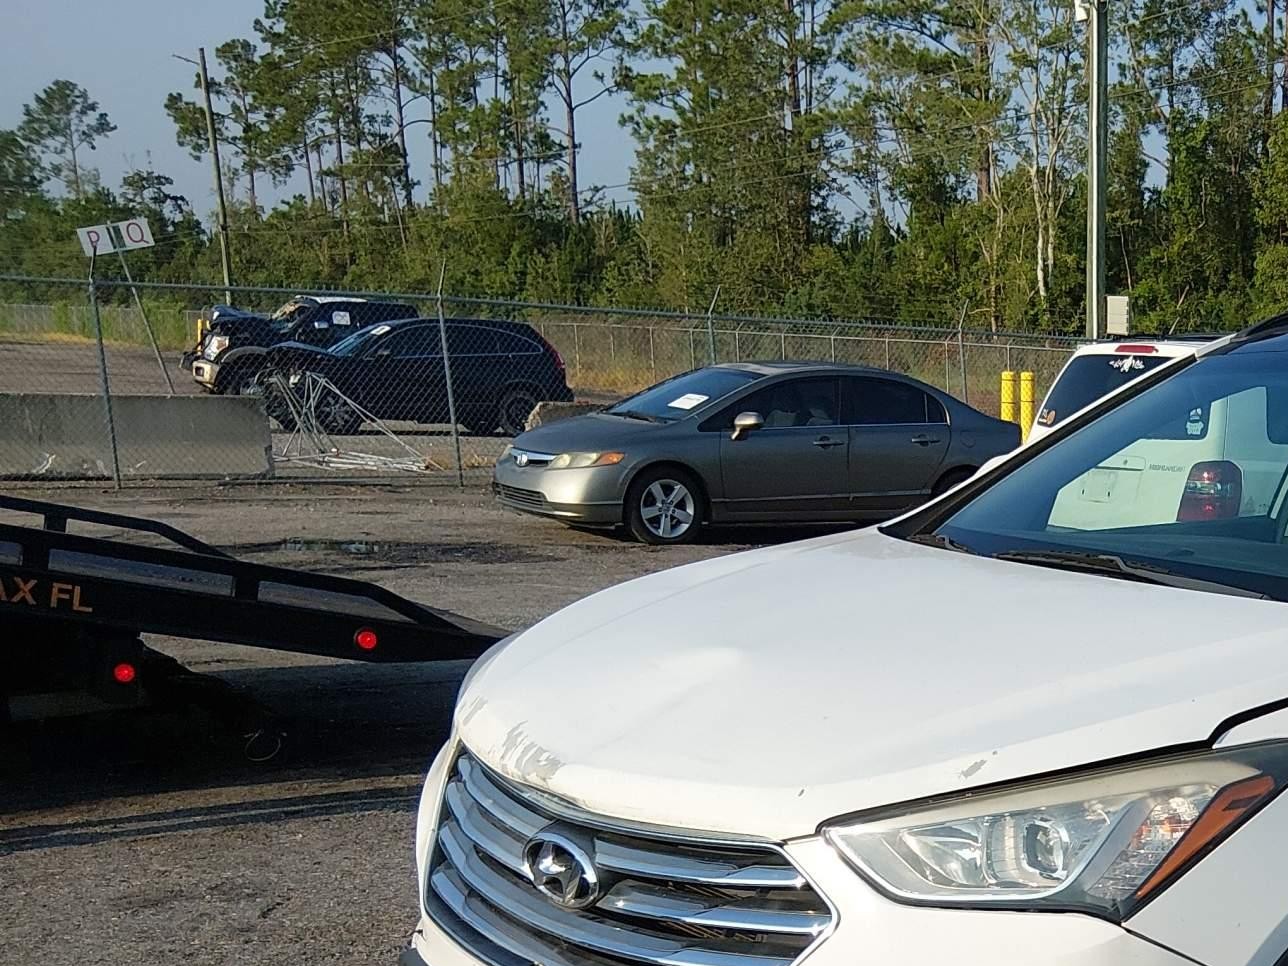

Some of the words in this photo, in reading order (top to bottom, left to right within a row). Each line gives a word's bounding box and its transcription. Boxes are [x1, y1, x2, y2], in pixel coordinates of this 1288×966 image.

[86, 230, 100, 248] P
[126, 222, 150, 244] Q
[50, 582, 93, 612] FL
